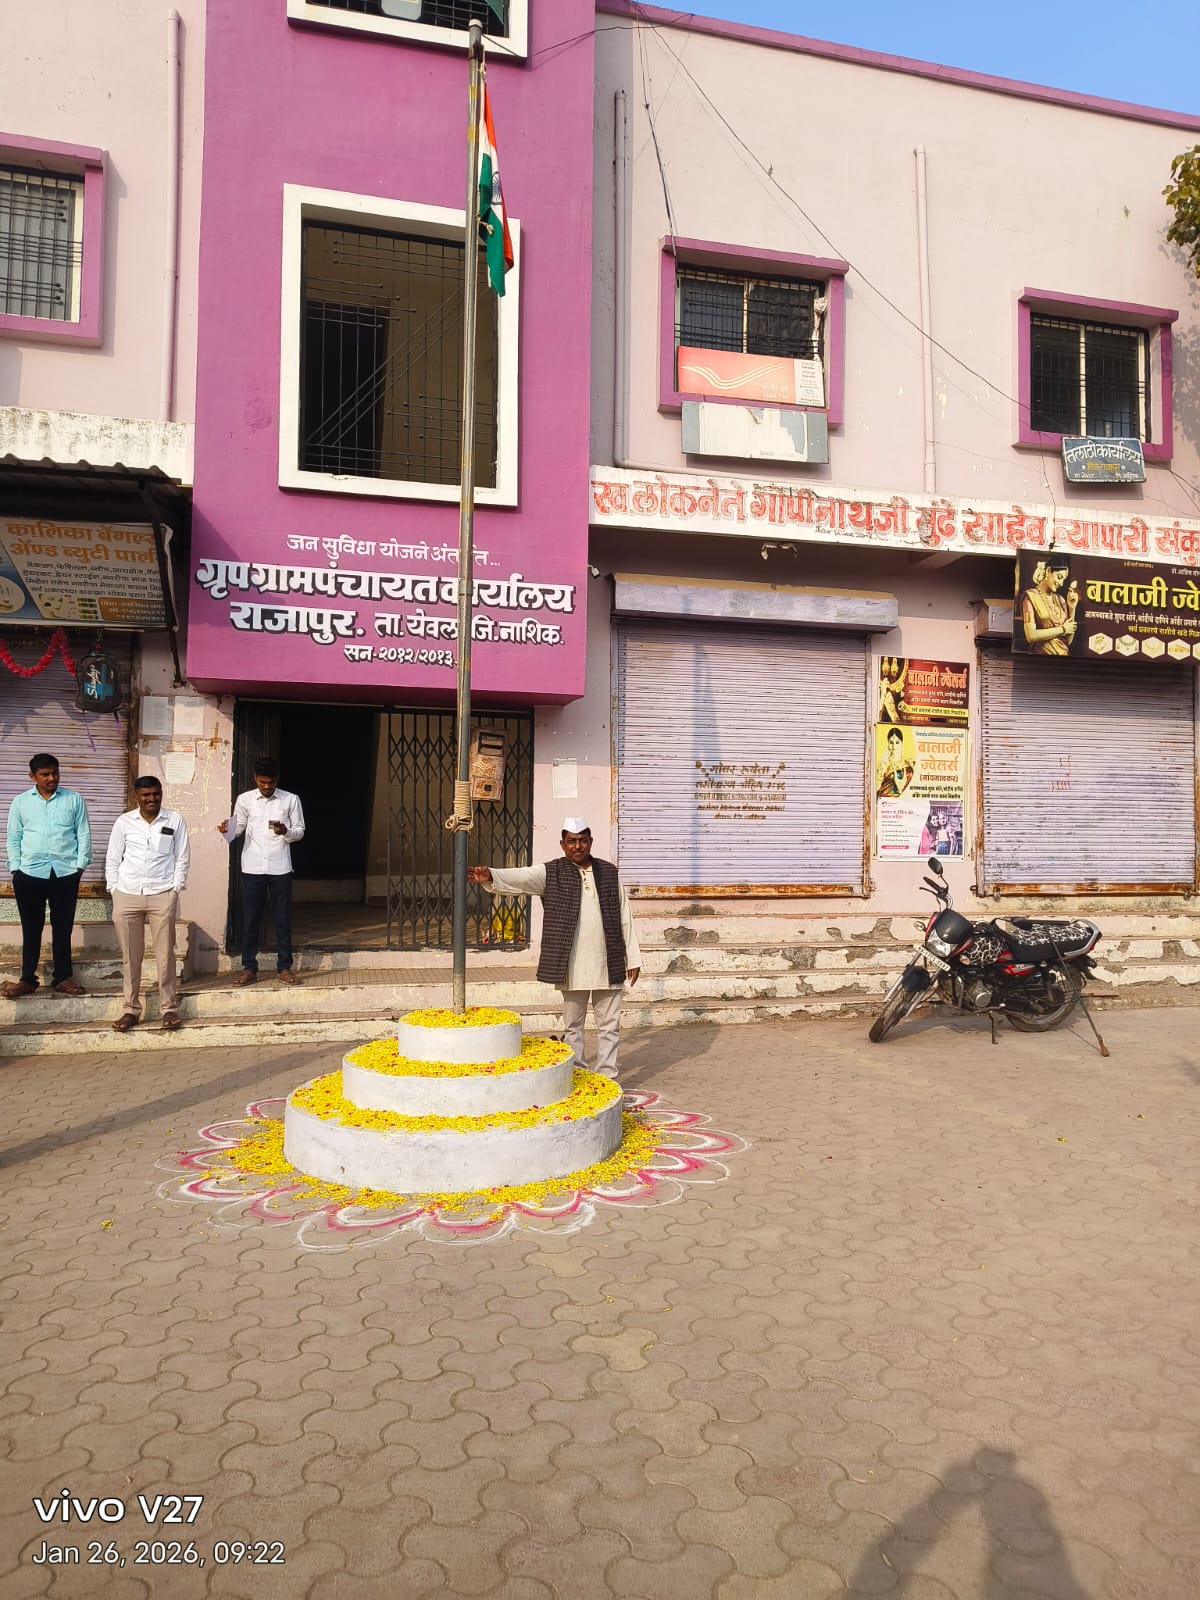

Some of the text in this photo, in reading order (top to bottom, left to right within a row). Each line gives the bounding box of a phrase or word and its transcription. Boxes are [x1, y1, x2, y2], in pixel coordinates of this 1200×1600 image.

[6, 521, 92, 541] कालिका
[1053, 516, 1150, 553] व्यापारी
[61, 543, 110, 564] ब्युटी
[287, 533, 319, 553] जन
[322, 533, 377, 559] सुविधा
[379, 538, 430, 560] योजने
[1086, 576, 1169, 608] बालाजी
[917, 738, 962, 755] बालाजी
[920, 754, 960, 772] ज्वेलर्स
